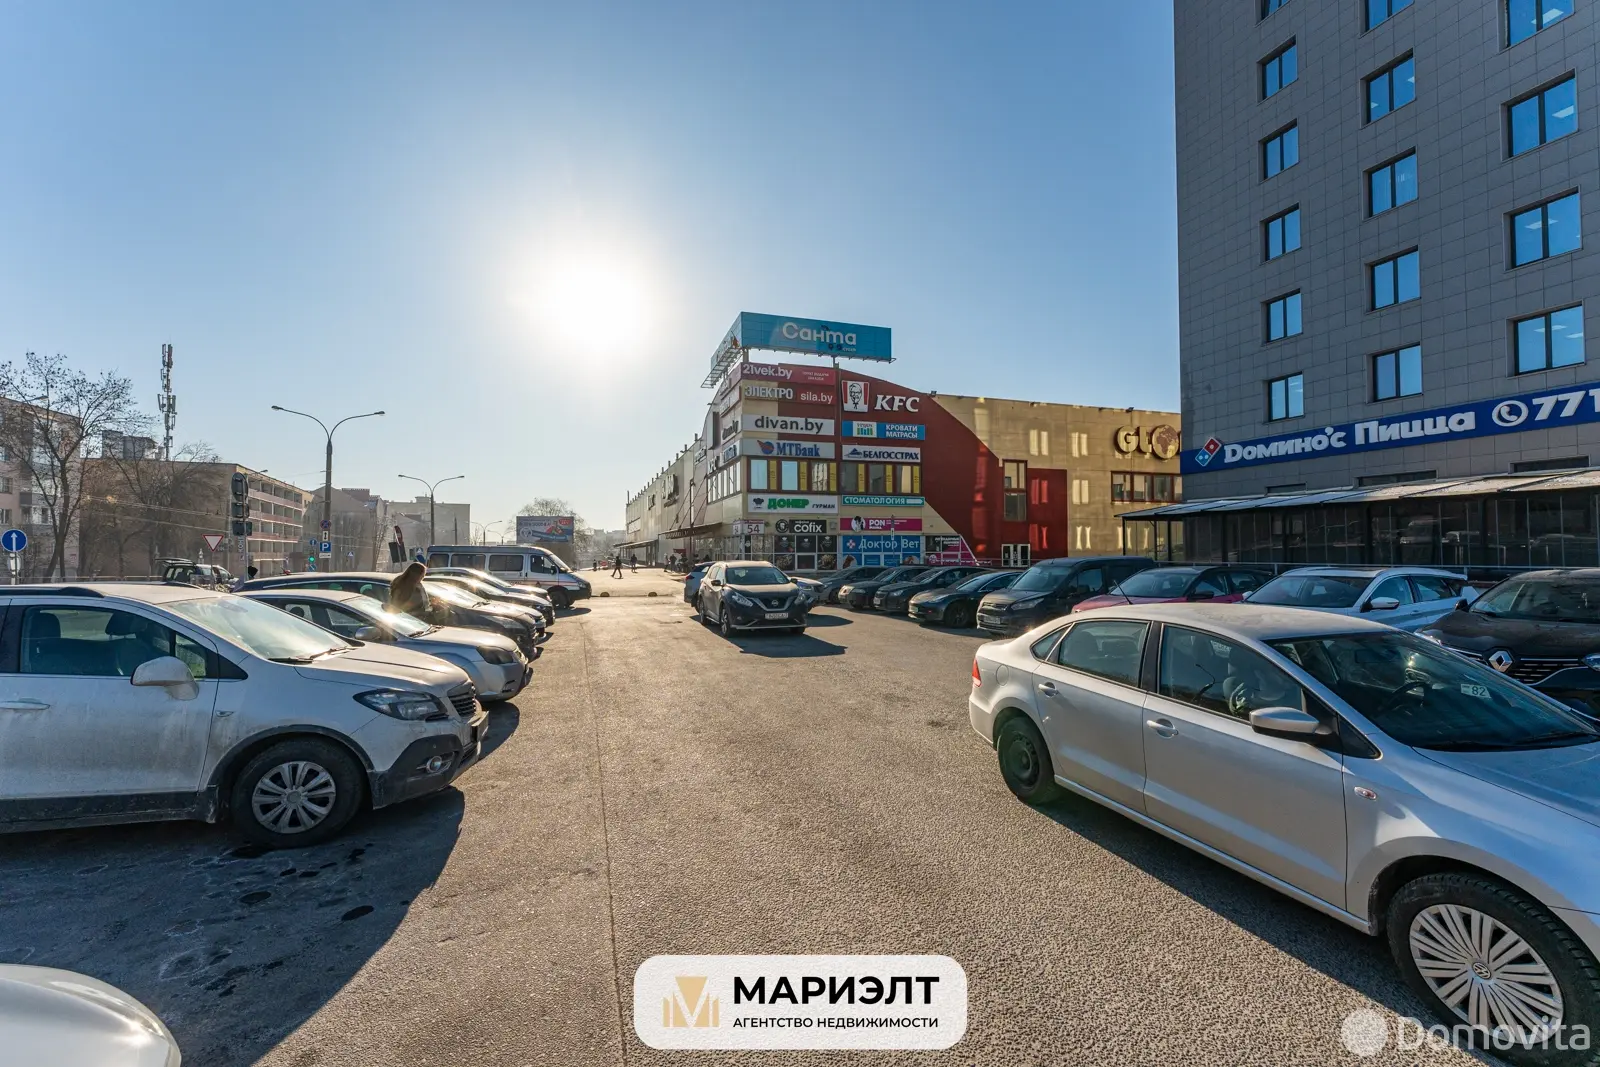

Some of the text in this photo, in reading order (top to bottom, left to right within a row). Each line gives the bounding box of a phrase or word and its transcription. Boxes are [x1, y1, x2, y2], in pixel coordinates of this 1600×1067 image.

[782, 322, 857, 345] Санта
[742, 363, 793, 379] 21vek.by
[744, 385, 833, 405] ЭЛЕКТРО sila.by
[874, 394, 920, 413] KFC
[754, 416, 824, 434] divan.by
[886, 424, 918, 432] КРОВАТИ
[1354, 411, 1476, 446] Пицца
[886, 431, 918, 439] МАТРАСЫ
[776, 442, 821, 457] МТБанк
[863, 451, 920, 460] БЕЛГОССТРАХ
[767, 498, 810, 510] ДОНЕР
[844, 496, 906, 505] СТОМАТОЛОГИЯ
[793, 522, 823, 533] cofix
[869, 519, 886, 527] PON
[747, 524, 761, 534] 54
[321, 543, 329, 551] P
[858, 538, 920, 550] Доктор Вет
[1472, 687, 1486, 696] 82
